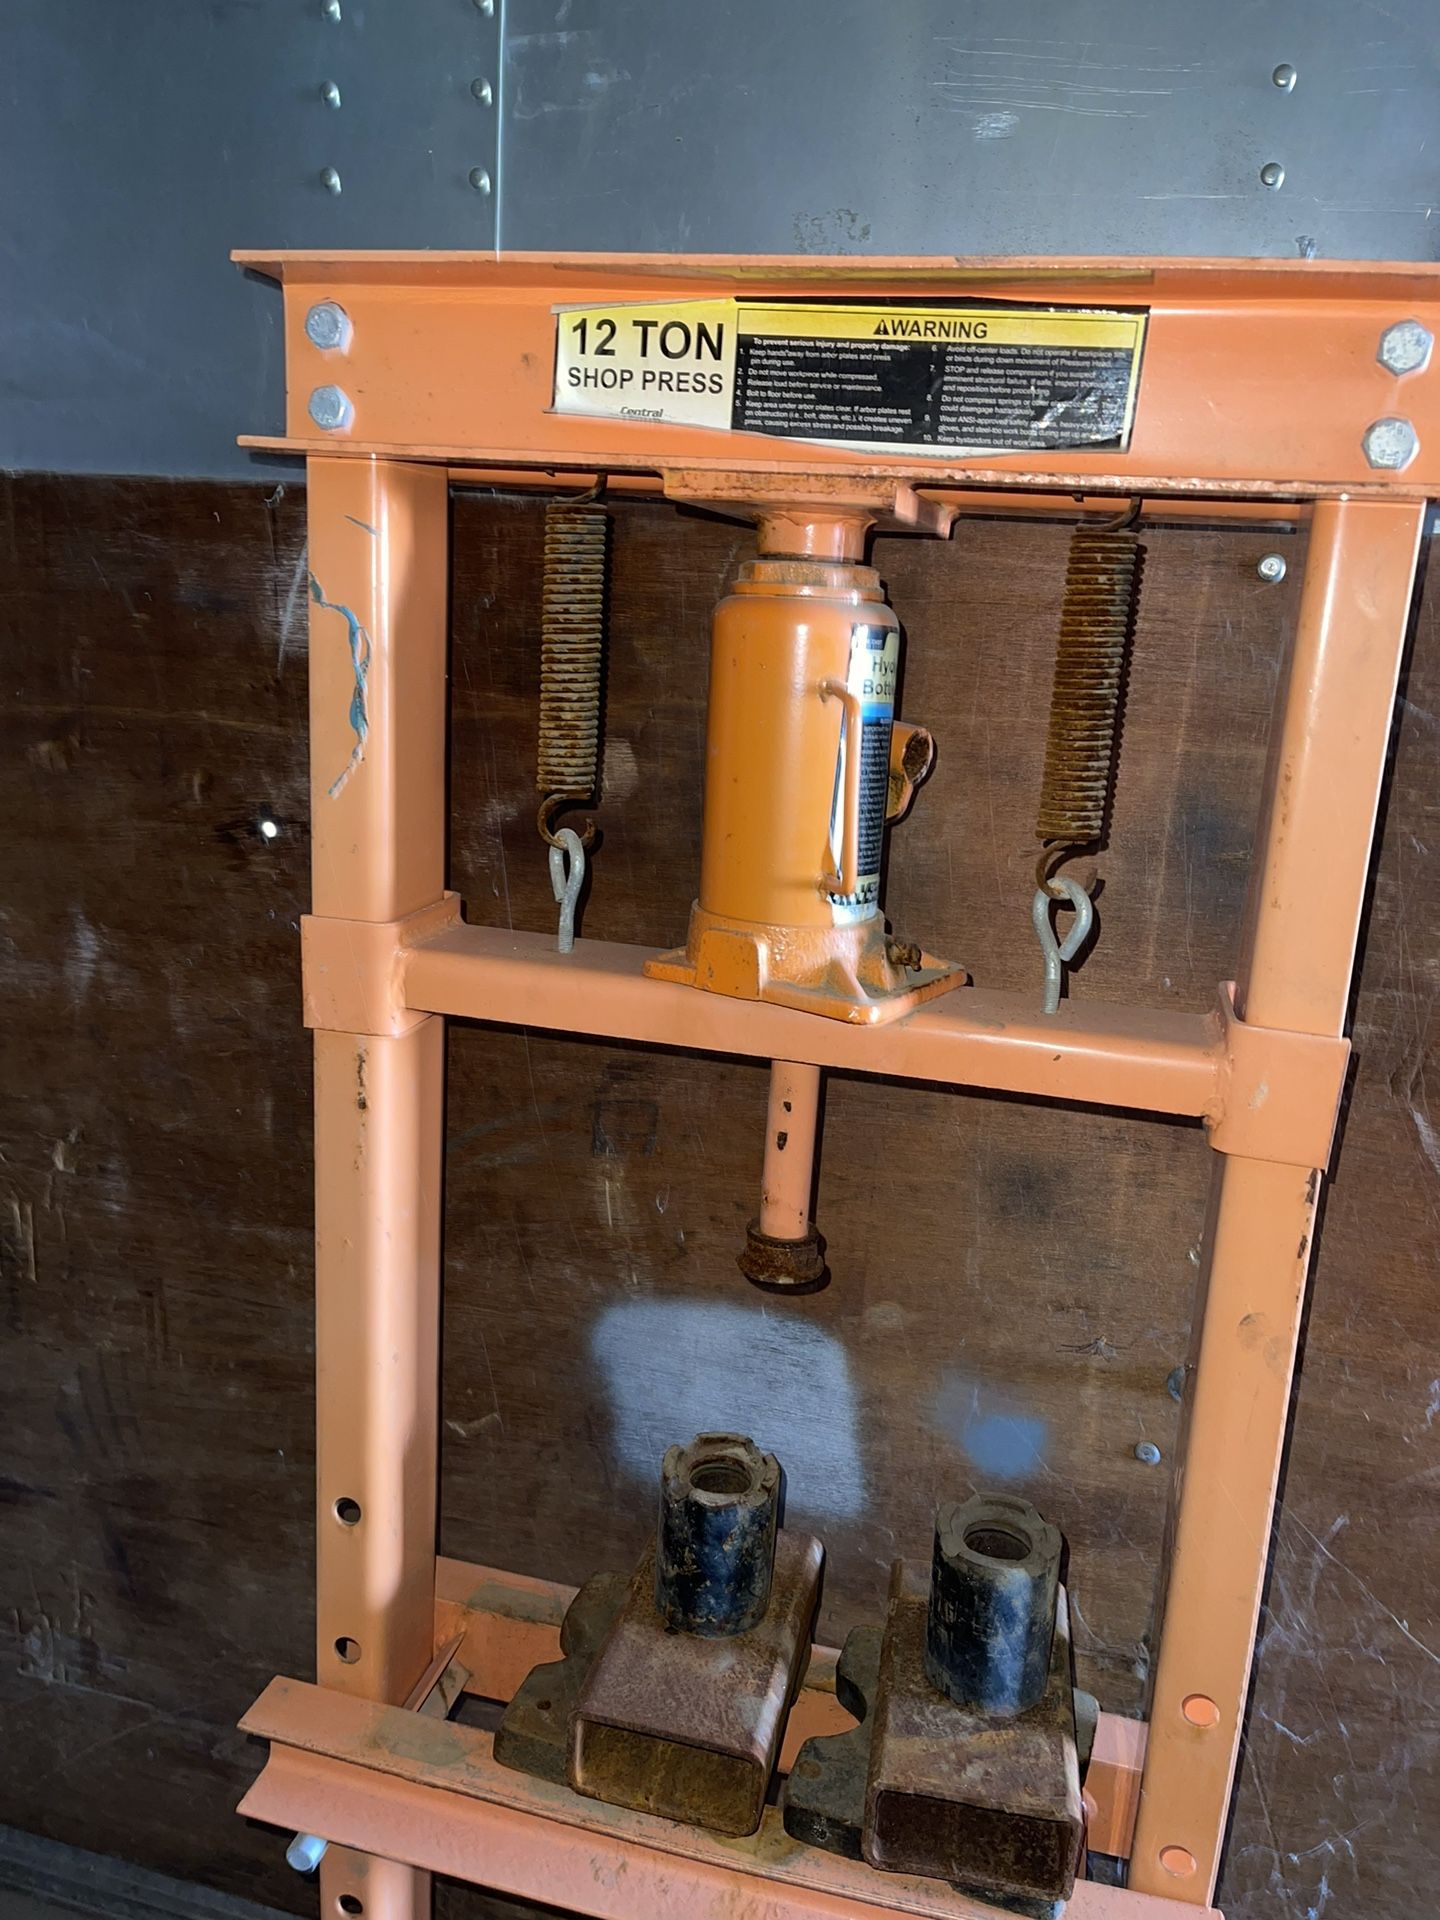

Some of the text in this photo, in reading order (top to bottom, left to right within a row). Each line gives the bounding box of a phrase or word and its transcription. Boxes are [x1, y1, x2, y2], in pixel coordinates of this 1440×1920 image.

[891, 319, 987, 339] WARNING
[572, 318, 724, 361] 12 TON
[944, 365, 965, 373] STOP
[568, 367, 723, 394] SHOP PRESS
[620, 406, 664, 418] Central
